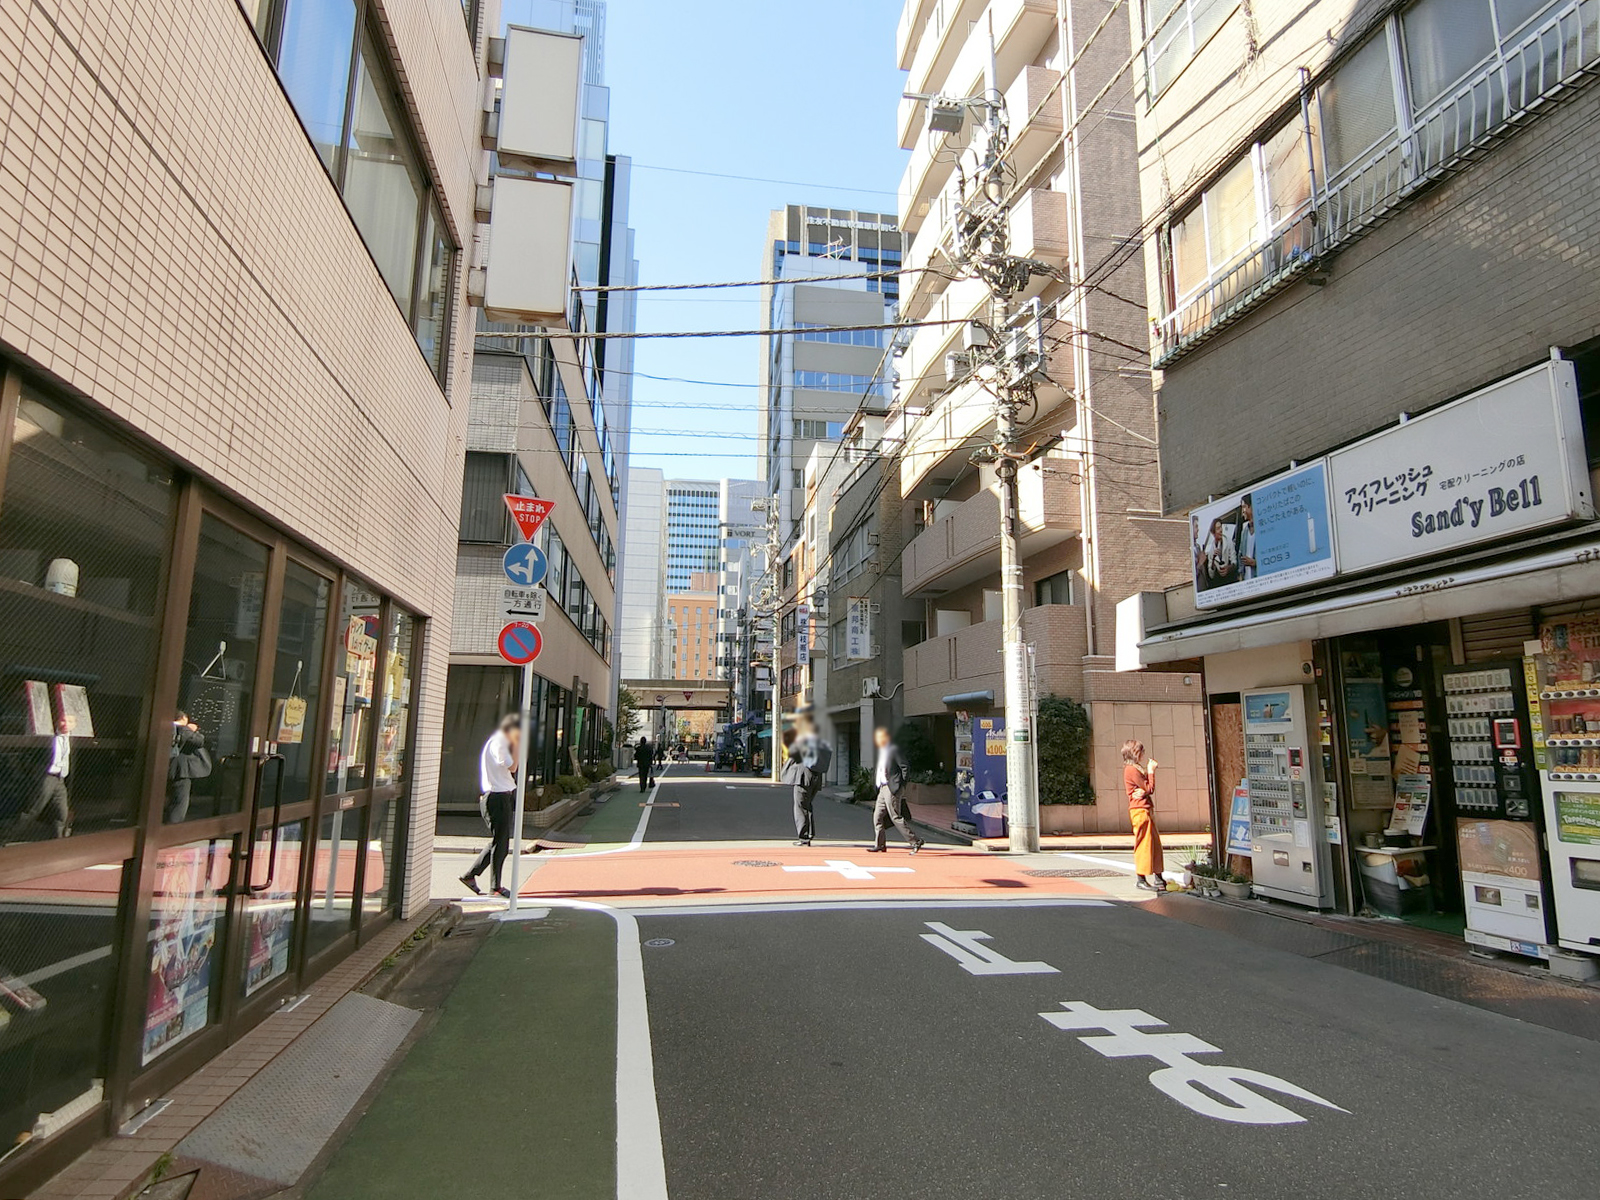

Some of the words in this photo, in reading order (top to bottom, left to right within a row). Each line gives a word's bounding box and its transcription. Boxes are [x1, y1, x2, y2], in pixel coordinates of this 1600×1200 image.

[1440, 454, 1525, 490] 宅配クリーニングの店
[1345, 465, 1433, 503] アイフレッシュ
[1351, 478, 1429, 516] クリーニング
[515, 501, 546, 513] 止まれ
[1411, 496, 1484, 538] Sand'y
[1488, 475, 1542, 517] Bell
[519, 513, 541, 523] STOP
[1261, 553, 1283, 567] IQOS
[1285, 551, 1291, 559] 3
[504, 589, 542, 599] 自転車を除く
[503, 600, 542, 610] 一方通行
